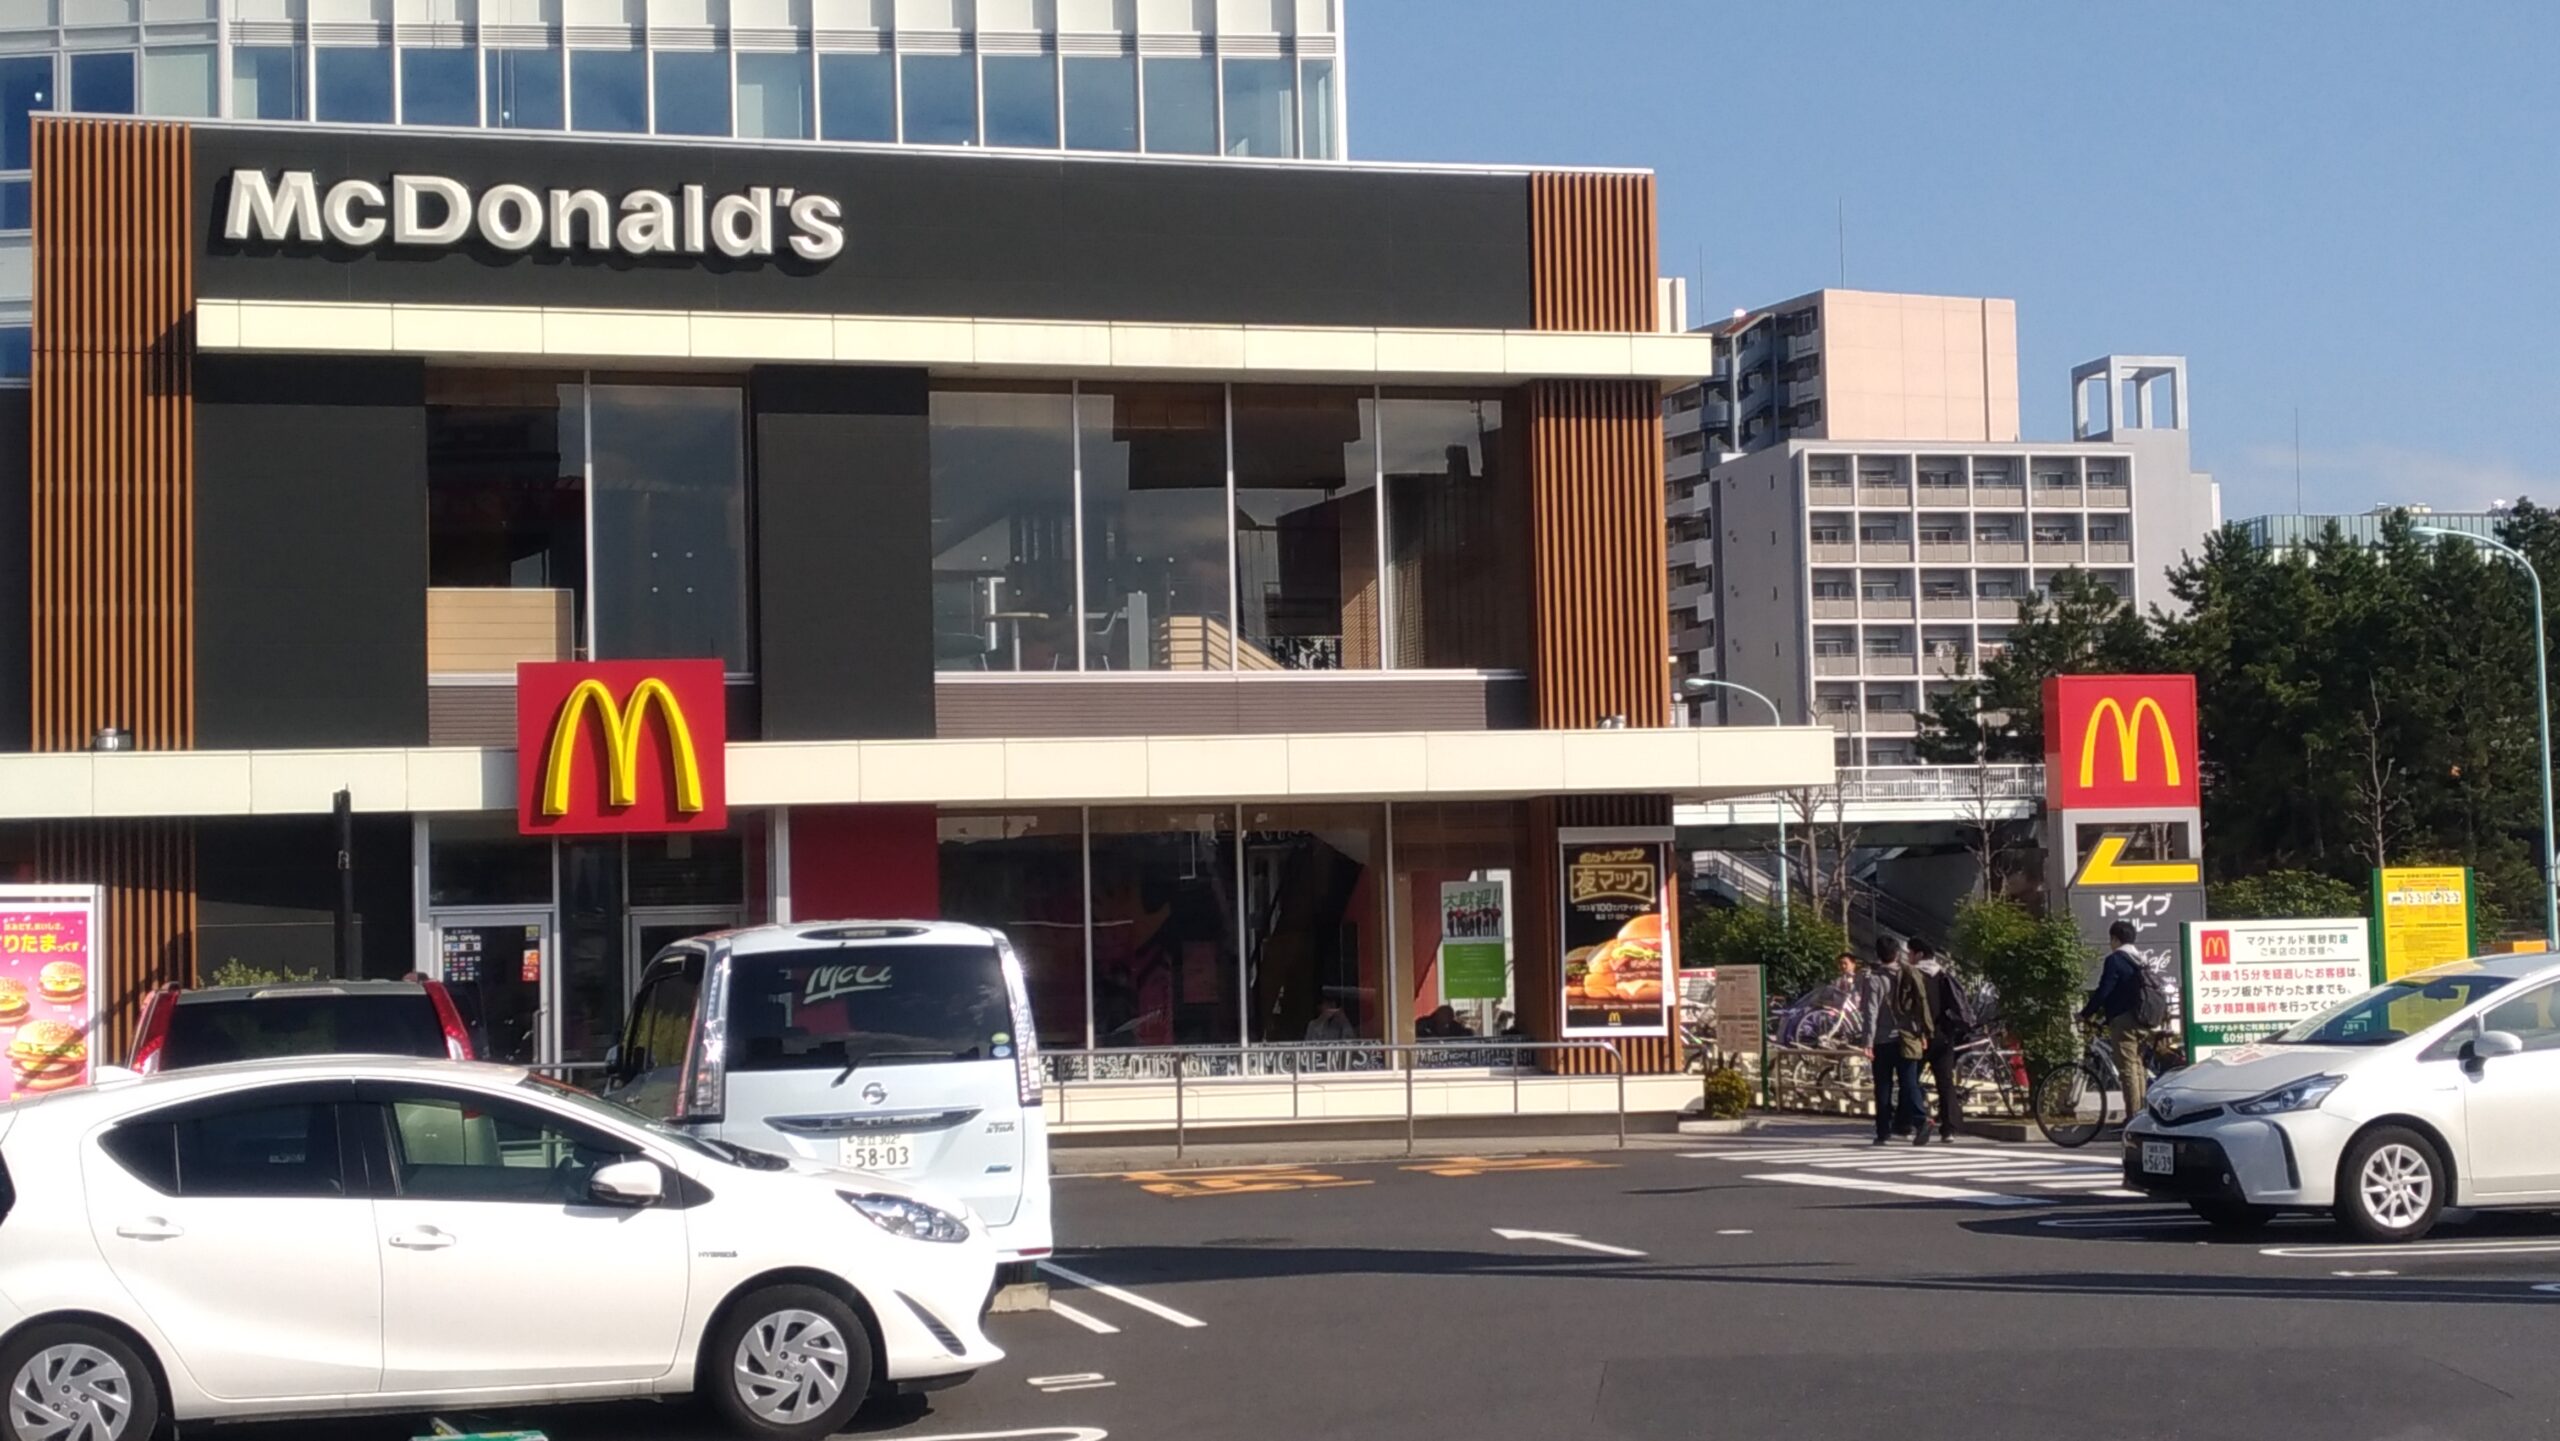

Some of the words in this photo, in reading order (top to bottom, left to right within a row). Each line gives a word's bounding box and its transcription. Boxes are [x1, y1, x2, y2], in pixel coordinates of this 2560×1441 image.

[224, 169, 845, 260] McDonald's
[1575, 868, 1649, 896] 夜マック
[2100, 892, 2173, 917] ドライブ
[856, 1147, 909, 1168] 58-03
